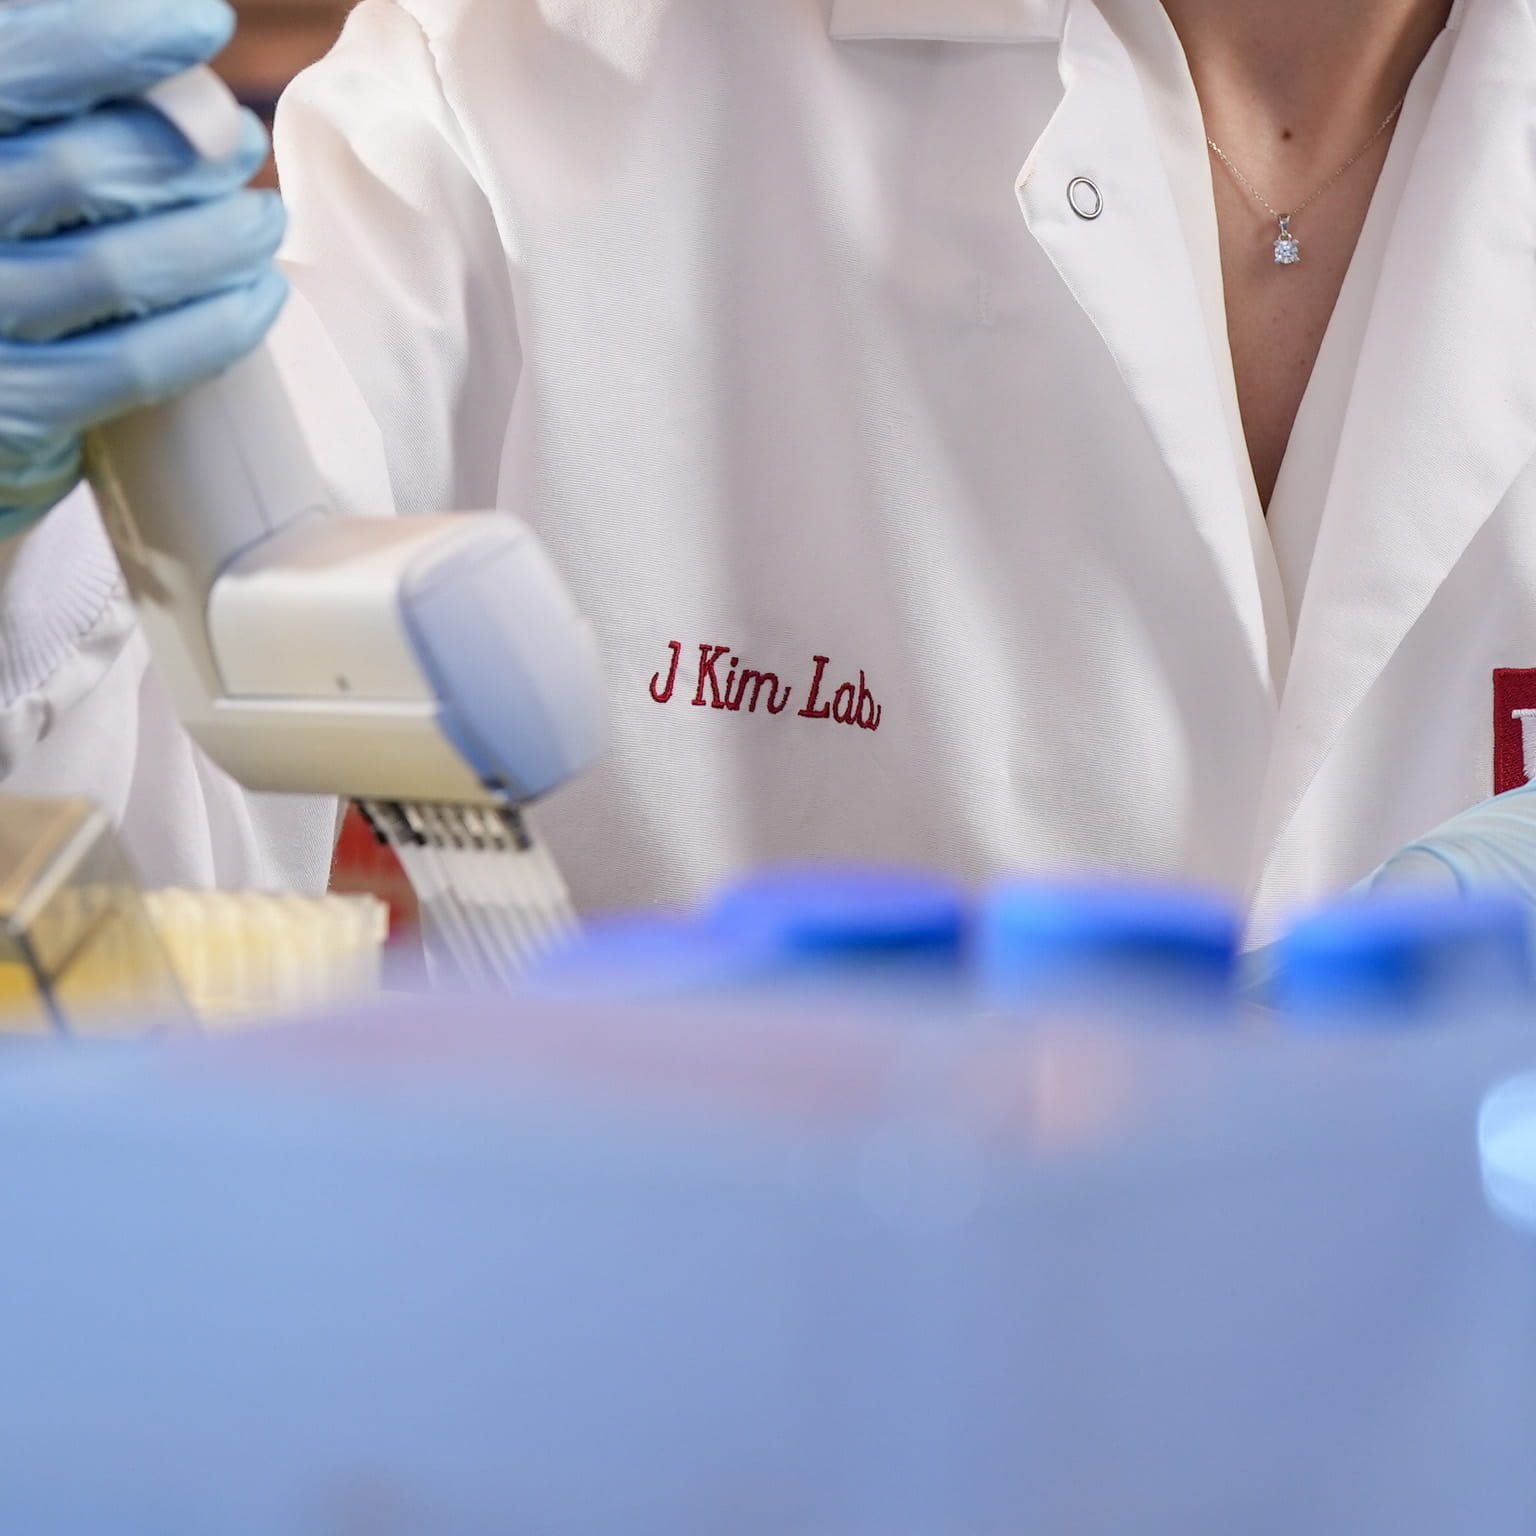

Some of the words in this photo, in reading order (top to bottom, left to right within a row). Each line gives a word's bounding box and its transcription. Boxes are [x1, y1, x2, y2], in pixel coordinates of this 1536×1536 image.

[649, 640, 681, 704] J
[691, 644, 791, 714] Kim
[797, 655, 882, 731] Lab
